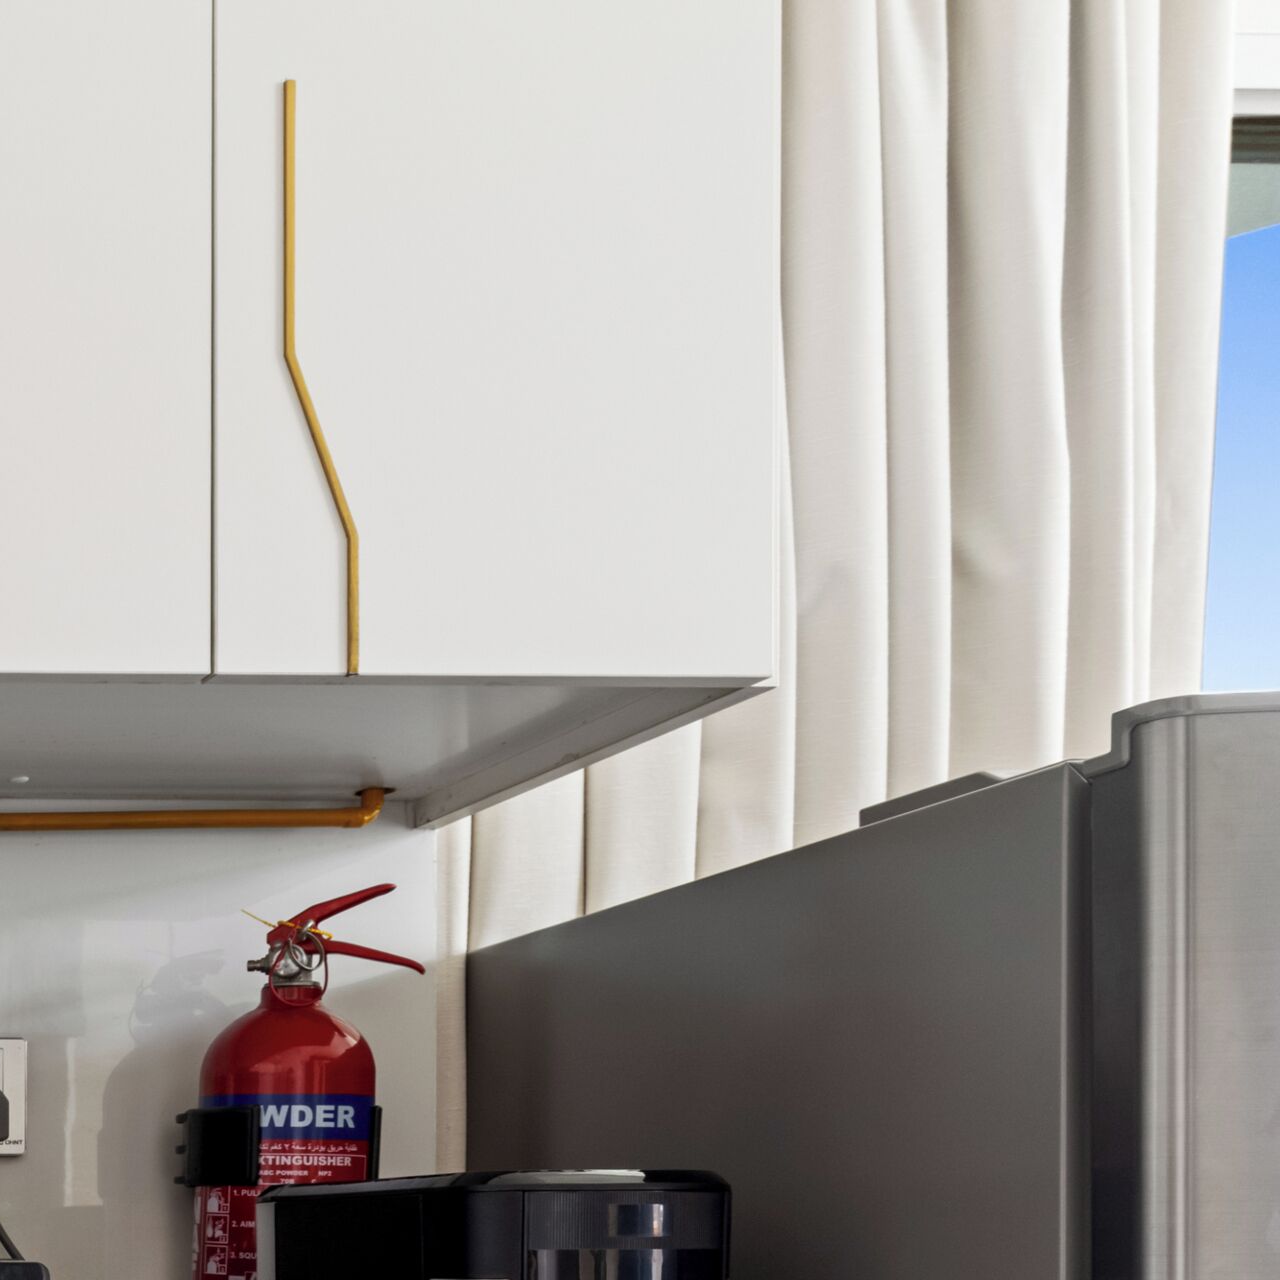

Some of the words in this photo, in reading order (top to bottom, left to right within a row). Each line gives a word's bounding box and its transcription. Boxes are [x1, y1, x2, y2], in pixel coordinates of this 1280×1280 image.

[260, 1104, 355, 1129] WDER
[258, 1155, 352, 1167] XTINGUISHER
[275, 1169, 309, 1177] POWDER
[238, 1251, 256, 1260] SQU
